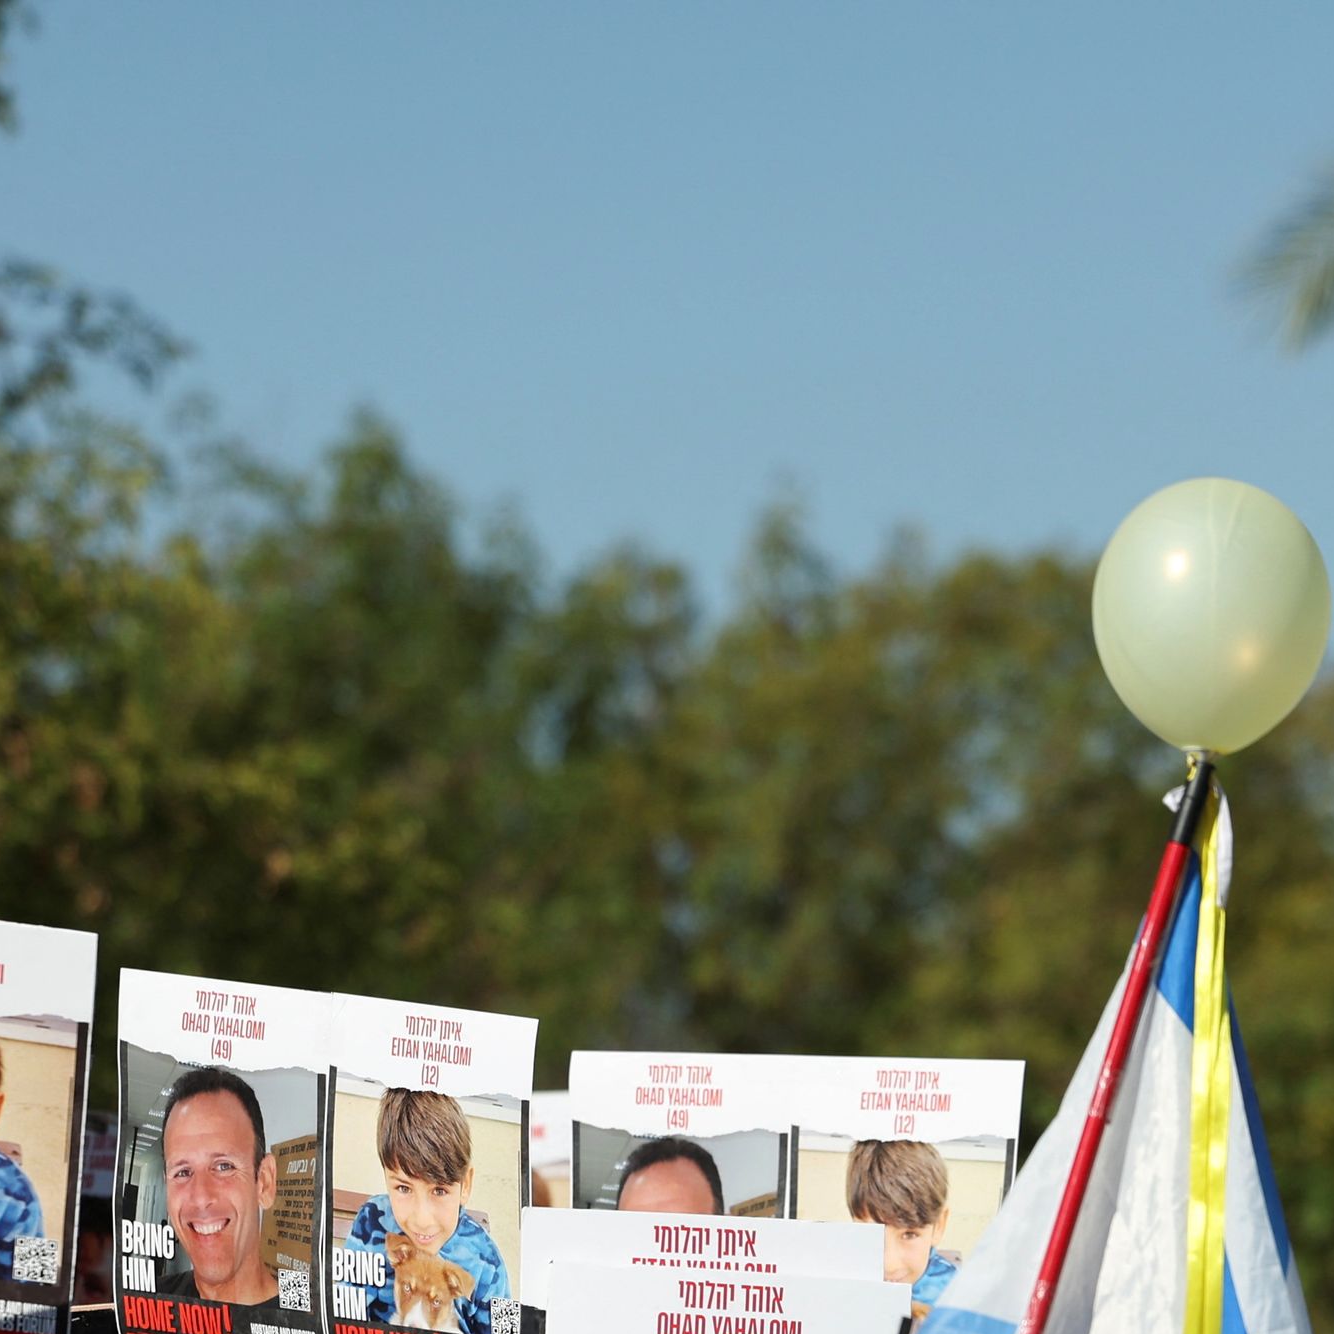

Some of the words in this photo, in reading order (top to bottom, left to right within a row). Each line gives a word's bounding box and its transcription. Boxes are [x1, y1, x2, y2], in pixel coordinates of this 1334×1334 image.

[196, 990, 228, 1012] יהלומי
[231, 994, 257, 1015] אוהד
[181, 1012, 210, 1034] OHAD
[213, 1016, 265, 1041] YAHALOMI
[405, 1016, 437, 1037] יהלומי
[439, 1021, 462, 1042] איתן
[210, 1038, 232, 1062] (49)
[391, 1037, 420, 1059] EITAN
[422, 1041, 472, 1066] YAHALOMI
[421, 1064, 440, 1087] (12)
[648, 1065, 683, 1084] יהלומי
[686, 1066, 712, 1085] אוהד
[876, 1070, 911, 1089] יהלומי
[915, 1071, 940, 1090] איתן
[635, 1087, 664, 1106] OHAD
[668, 1087, 723, 1107] YAHALOMI
[860, 1091, 891, 1111] EITAN
[896, 1093, 951, 1112] YAHALOMI
[666, 1109, 689, 1130] (49)
[894, 1115, 915, 1135] (12)
[121, 1219, 175, 1260] BRING
[654, 1225, 710, 1255] יהלומי
[717, 1228, 756, 1258] איתן
[121, 1256, 157, 1293] HIM
[332, 1247, 386, 1287] BRING
[332, 1284, 368, 1322] HIM
[679, 1280, 735, 1310] יהלומי
[741, 1284, 784, 1314] אוהד
[123, 1294, 177, 1334] HOME
